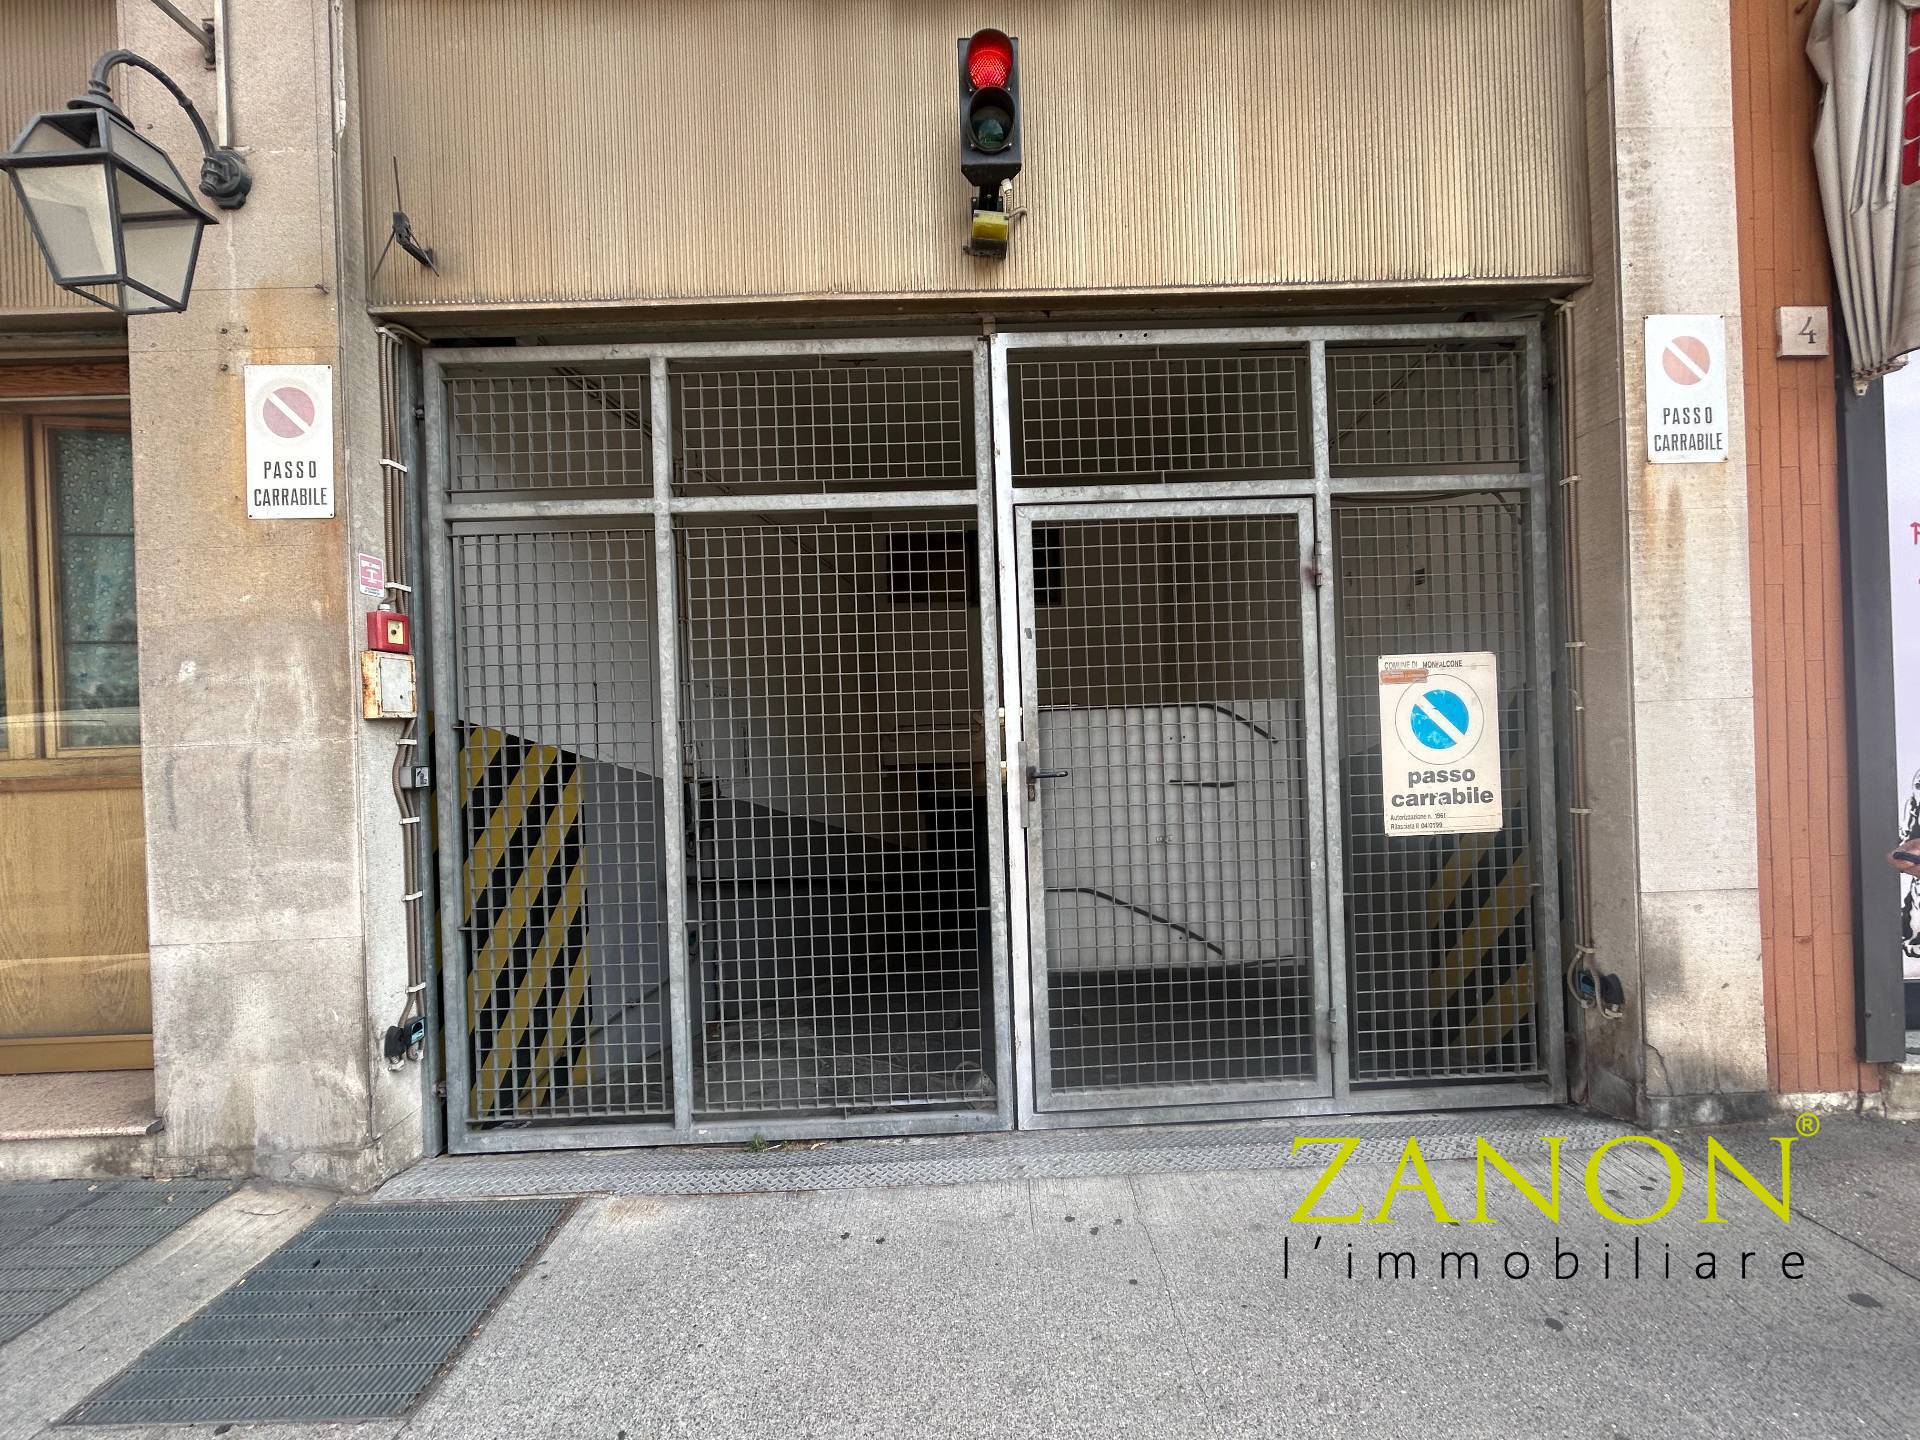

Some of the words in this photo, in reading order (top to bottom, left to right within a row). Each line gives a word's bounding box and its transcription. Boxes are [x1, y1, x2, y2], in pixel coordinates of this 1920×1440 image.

[1798, 316, 1817, 344] 4
[1663, 407, 1713, 425] PASSO
[1654, 432, 1723, 452] CARRABILE
[264, 460, 317, 479] PASSO
[254, 487, 328, 507] CARRABILE
[1384, 661, 1410, 671] COMUNE
[1411, 660, 1418, 669] DI
[1422, 659, 1463, 669] MONFALCONE
[1408, 768, 1476, 788] passo
[1391, 786, 1494, 808] carrabile
